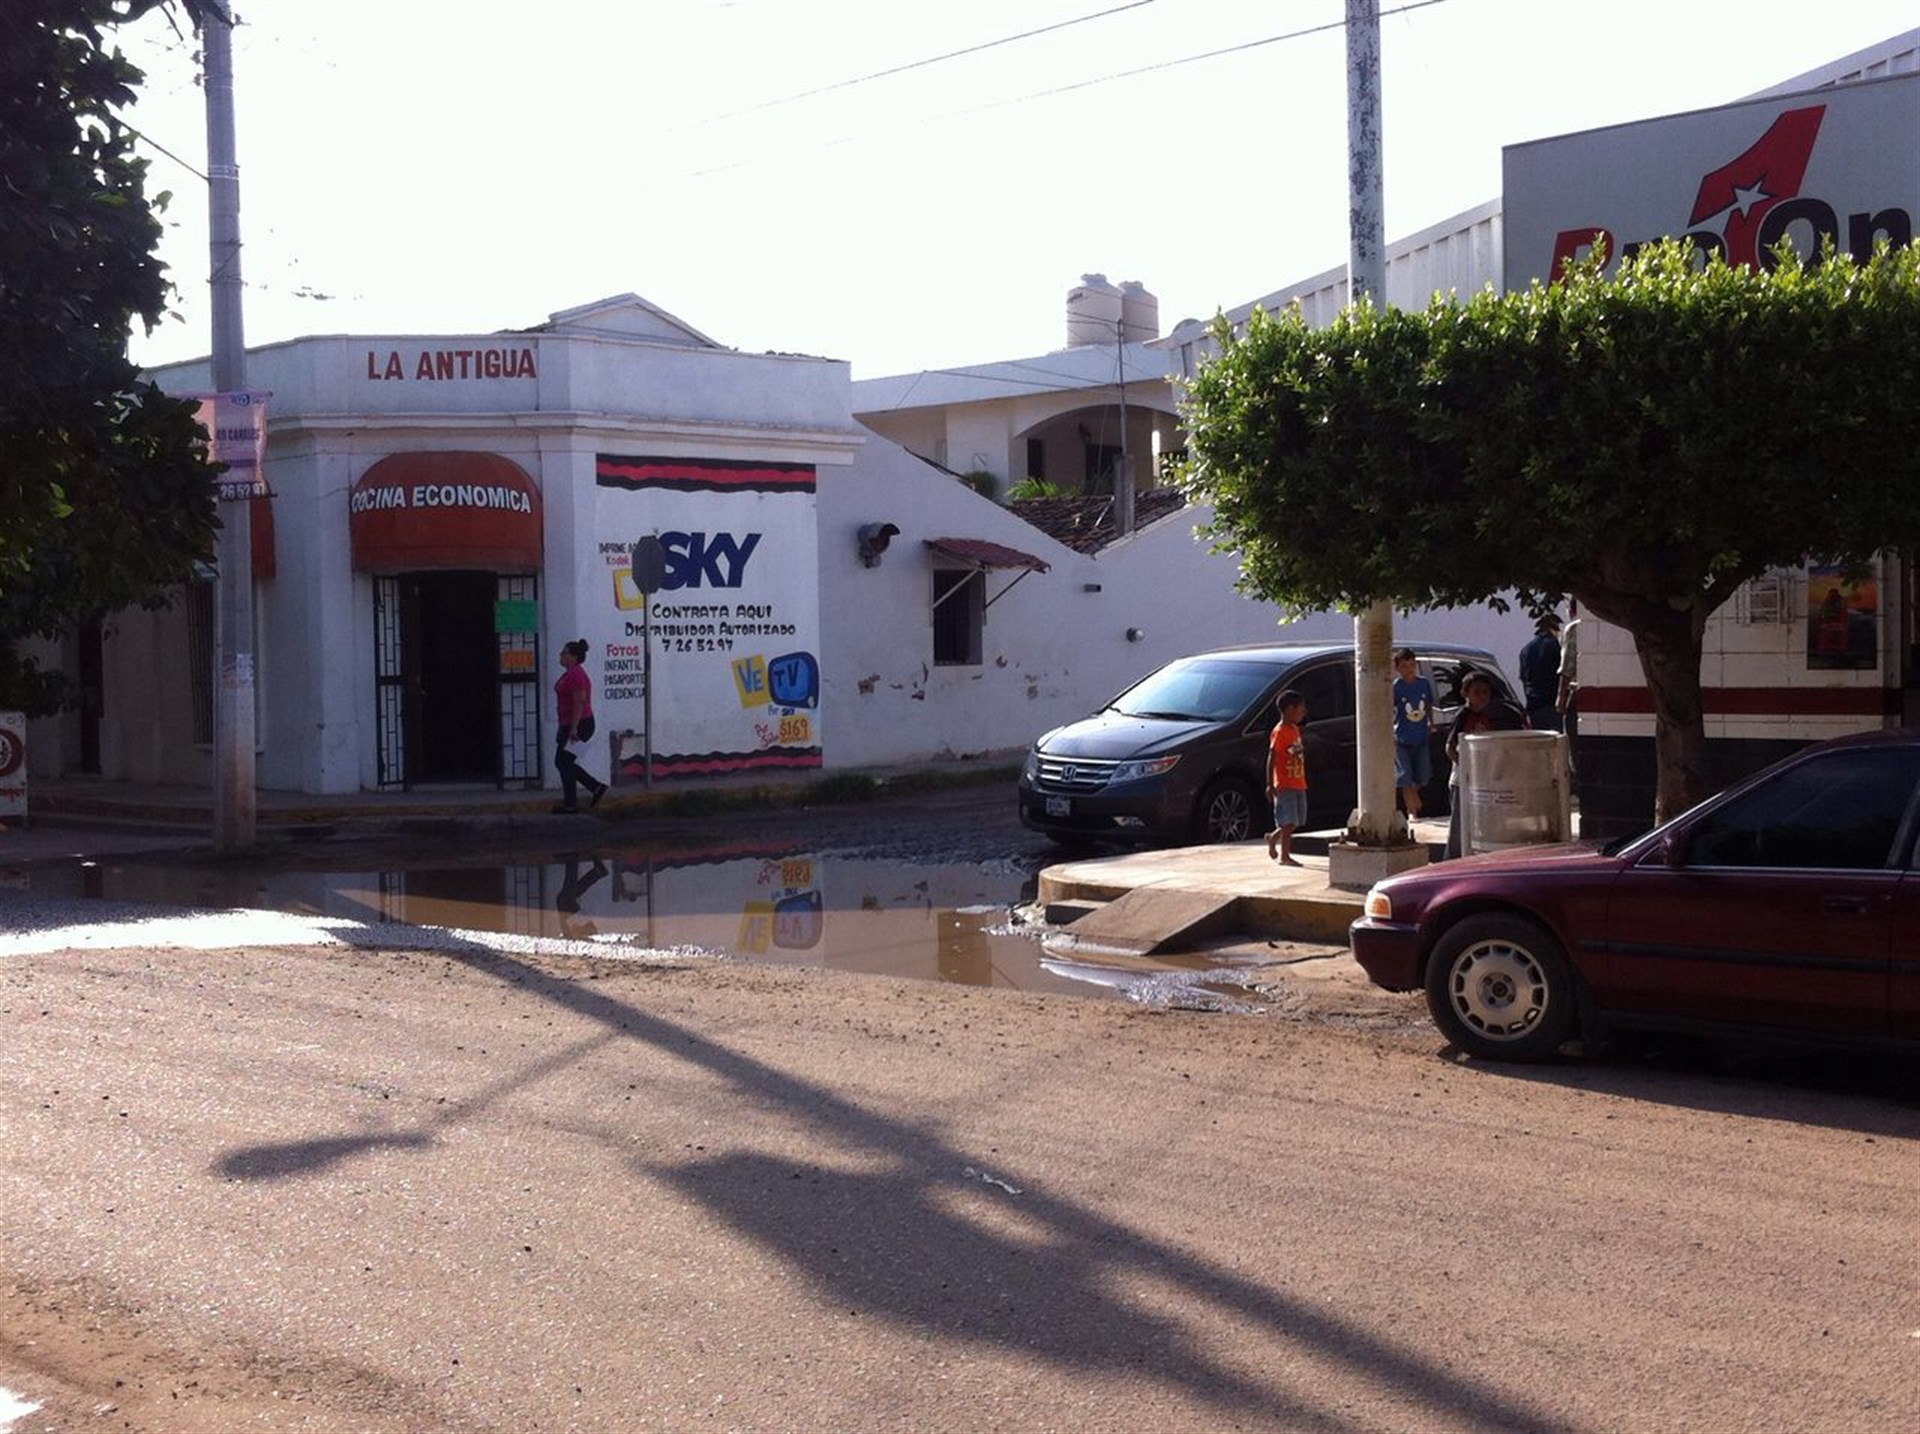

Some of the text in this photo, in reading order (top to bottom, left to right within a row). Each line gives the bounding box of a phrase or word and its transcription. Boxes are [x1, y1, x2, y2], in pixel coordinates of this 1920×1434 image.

[367, 348, 537, 380] LA ANTIGUA
[351, 484, 532, 513] COCINA ECONOMICA
[655, 530, 762, 591] SKY
[652, 603, 772, 620] CONTRATA AQUI
[719, 621, 796, 636] AUTORIZADO
[606, 643, 640, 657] FOTOS
[604, 659, 642, 671] INFANTIL
[774, 660, 800, 688] TV
[604, 686, 649, 700] CREDENCIA
[779, 718, 808, 740] $169
